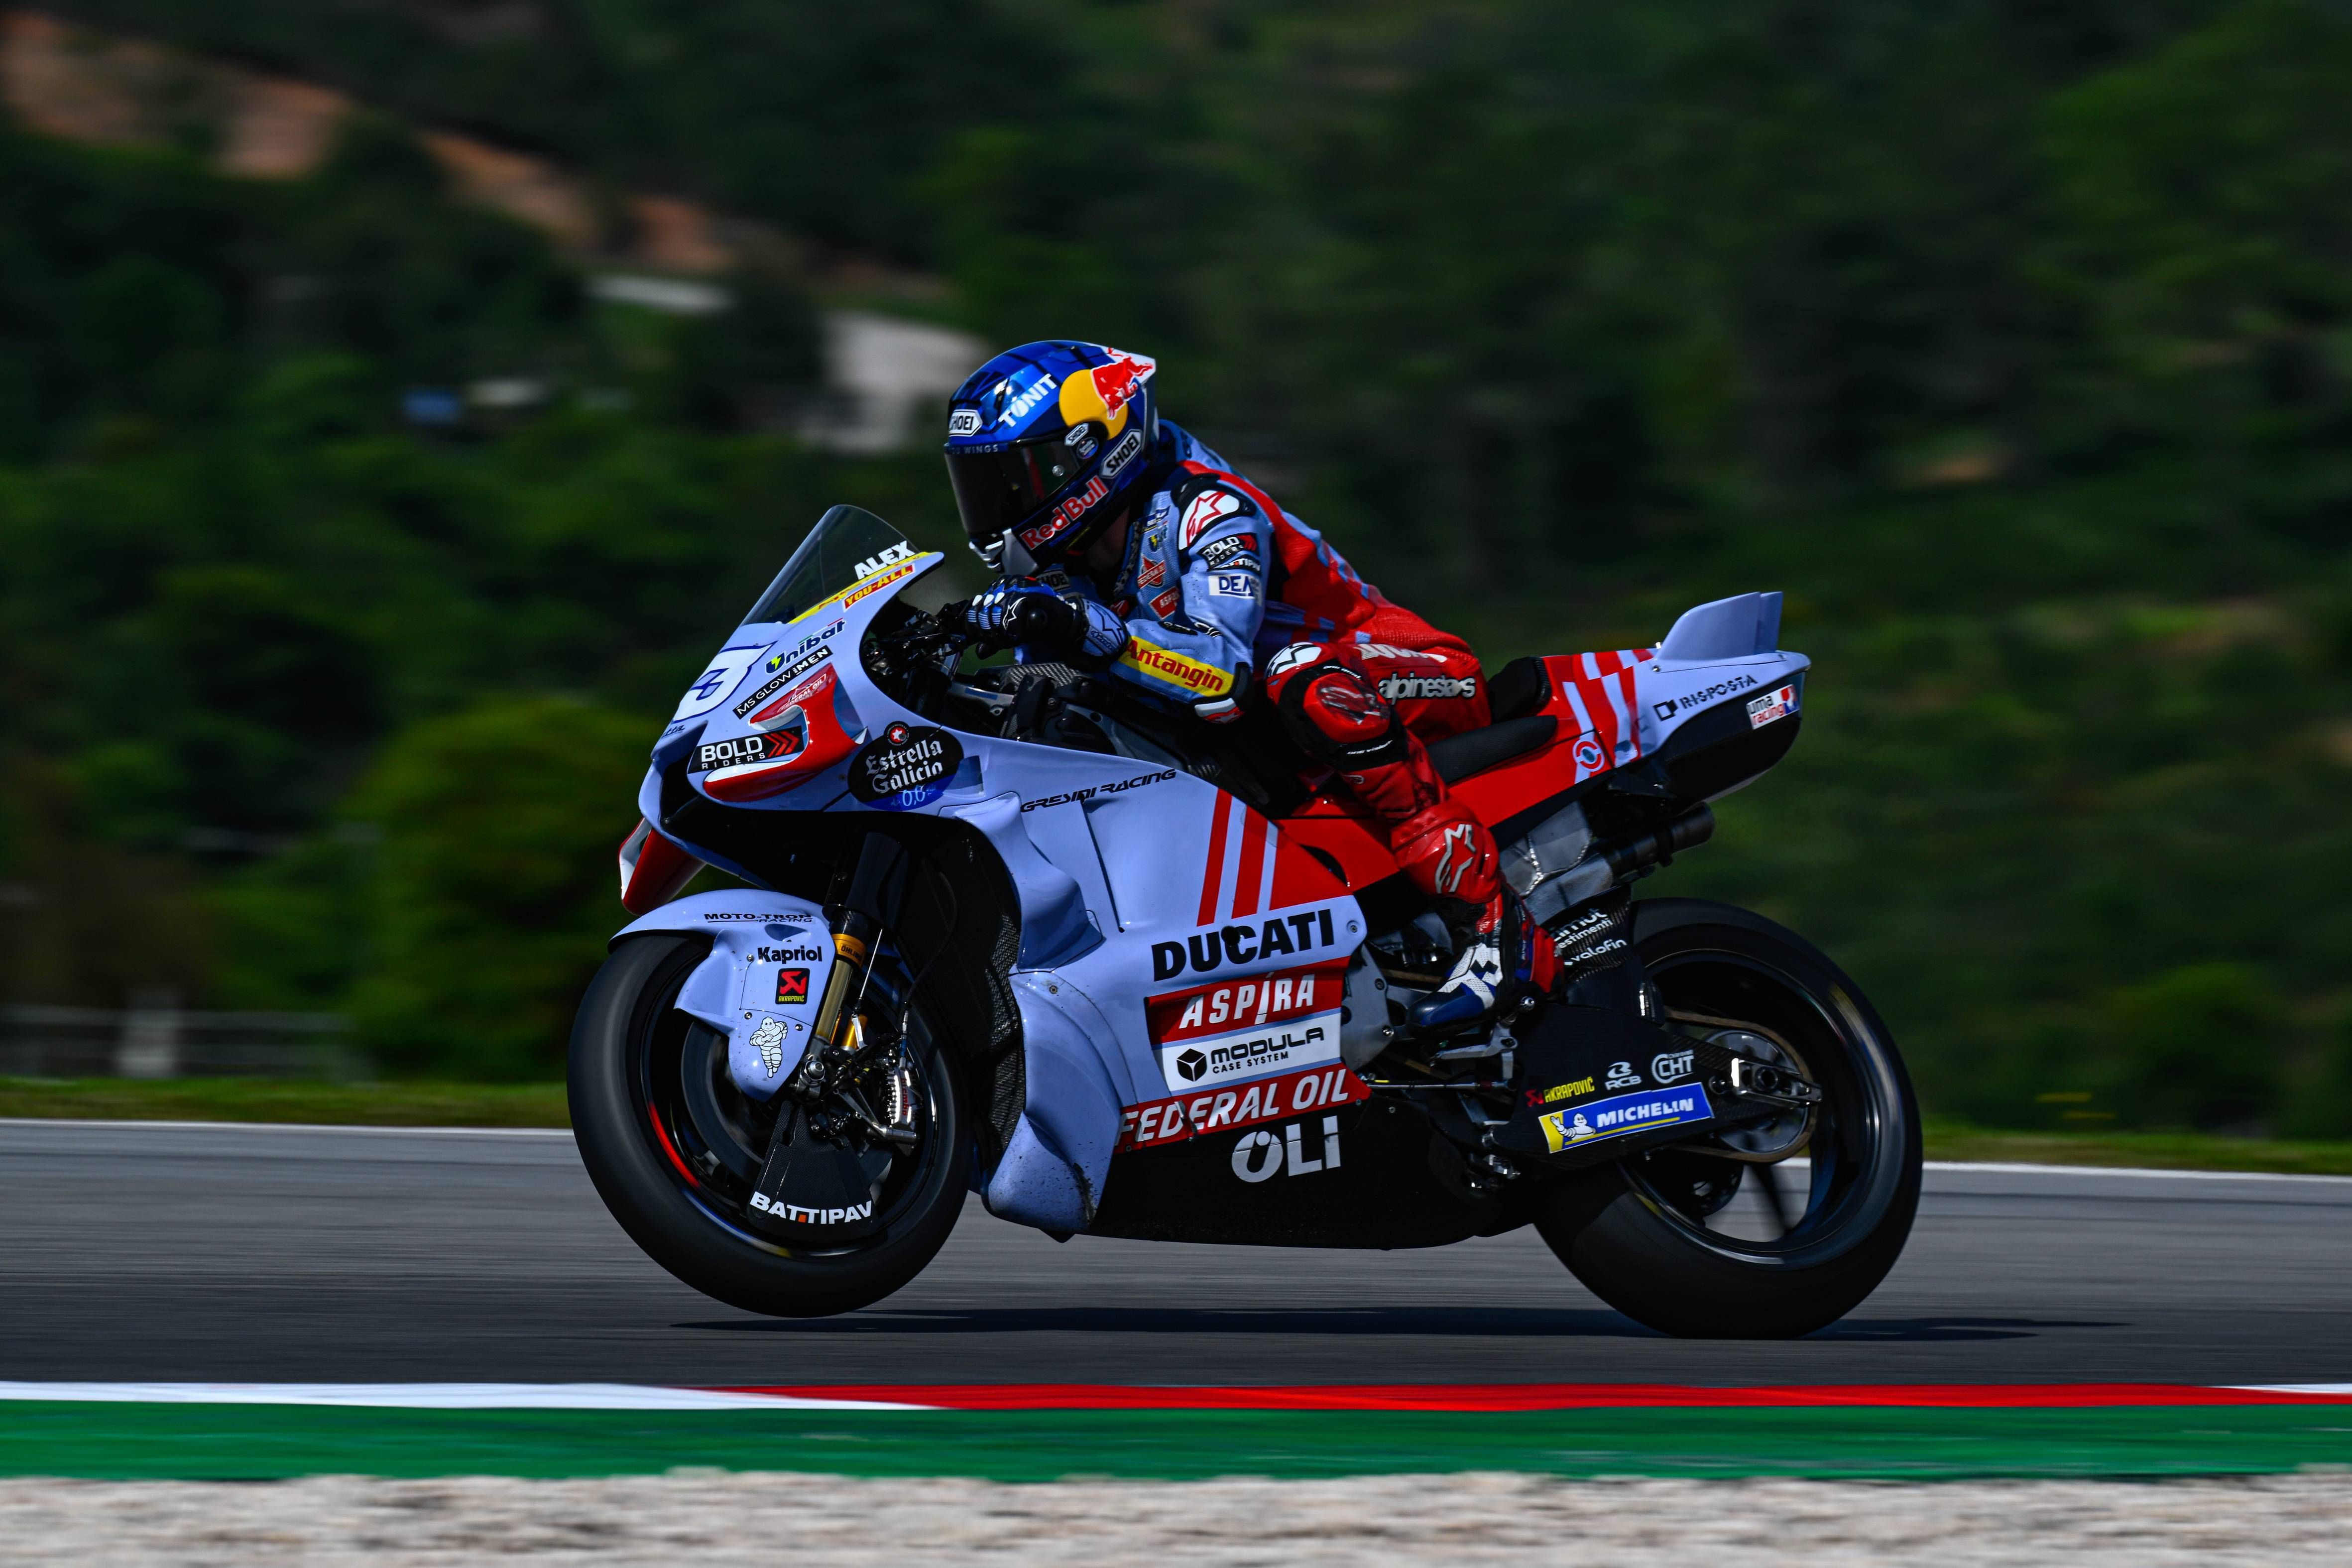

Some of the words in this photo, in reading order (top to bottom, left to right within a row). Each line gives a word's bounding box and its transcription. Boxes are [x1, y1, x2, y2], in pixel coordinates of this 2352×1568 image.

[949, 415, 974, 431] HOEI
[963, 444, 999, 454] WINGS
[1106, 434, 1140, 474] SHOEI
[1020, 508, 1070, 550] Red
[1062, 475, 1110, 521] Bull
[854, 540, 915, 580] ALEX
[1202, 537, 1240, 561] BOLD
[1209, 545, 1244, 566] RIDERS
[845, 566, 912, 605] YOU-ALL
[766, 620, 846, 674] Unibat
[1127, 640, 1223, 692] Antangin
[736, 698, 756, 715] MS
[756, 671, 791, 699] GLOW
[1747, 696, 1773, 714] uma
[1753, 704, 1784, 725] racing
[701, 736, 763, 762] BOLD
[702, 752, 765, 769] RIDERS
[866, 739, 944, 776] Estrella
[872, 760, 943, 794] Galicia
[1021, 787, 1096, 813] GRESINI
[1100, 769, 1176, 793] RACING
[757, 946, 823, 964] Kapriol
[1151, 909, 1335, 982] DUCATI
[1570, 939, 1628, 962] valofin
[1211, 1027, 1324, 1065] MODULA
[1213, 1061, 1242, 1074] CASE
[1247, 1051, 1290, 1067] SYSTEM
[1605, 1075, 1643, 1090] RCB
[1658, 1055, 1694, 1077] CHT
[1115, 1083, 1280, 1146] FEDERAL
[1292, 1069, 1349, 1110] OIL
[1597, 1097, 1694, 1128] MICHELIN
[1231, 1115, 1341, 1183] OLI
[749, 1191, 872, 1224] BATTIPAV
